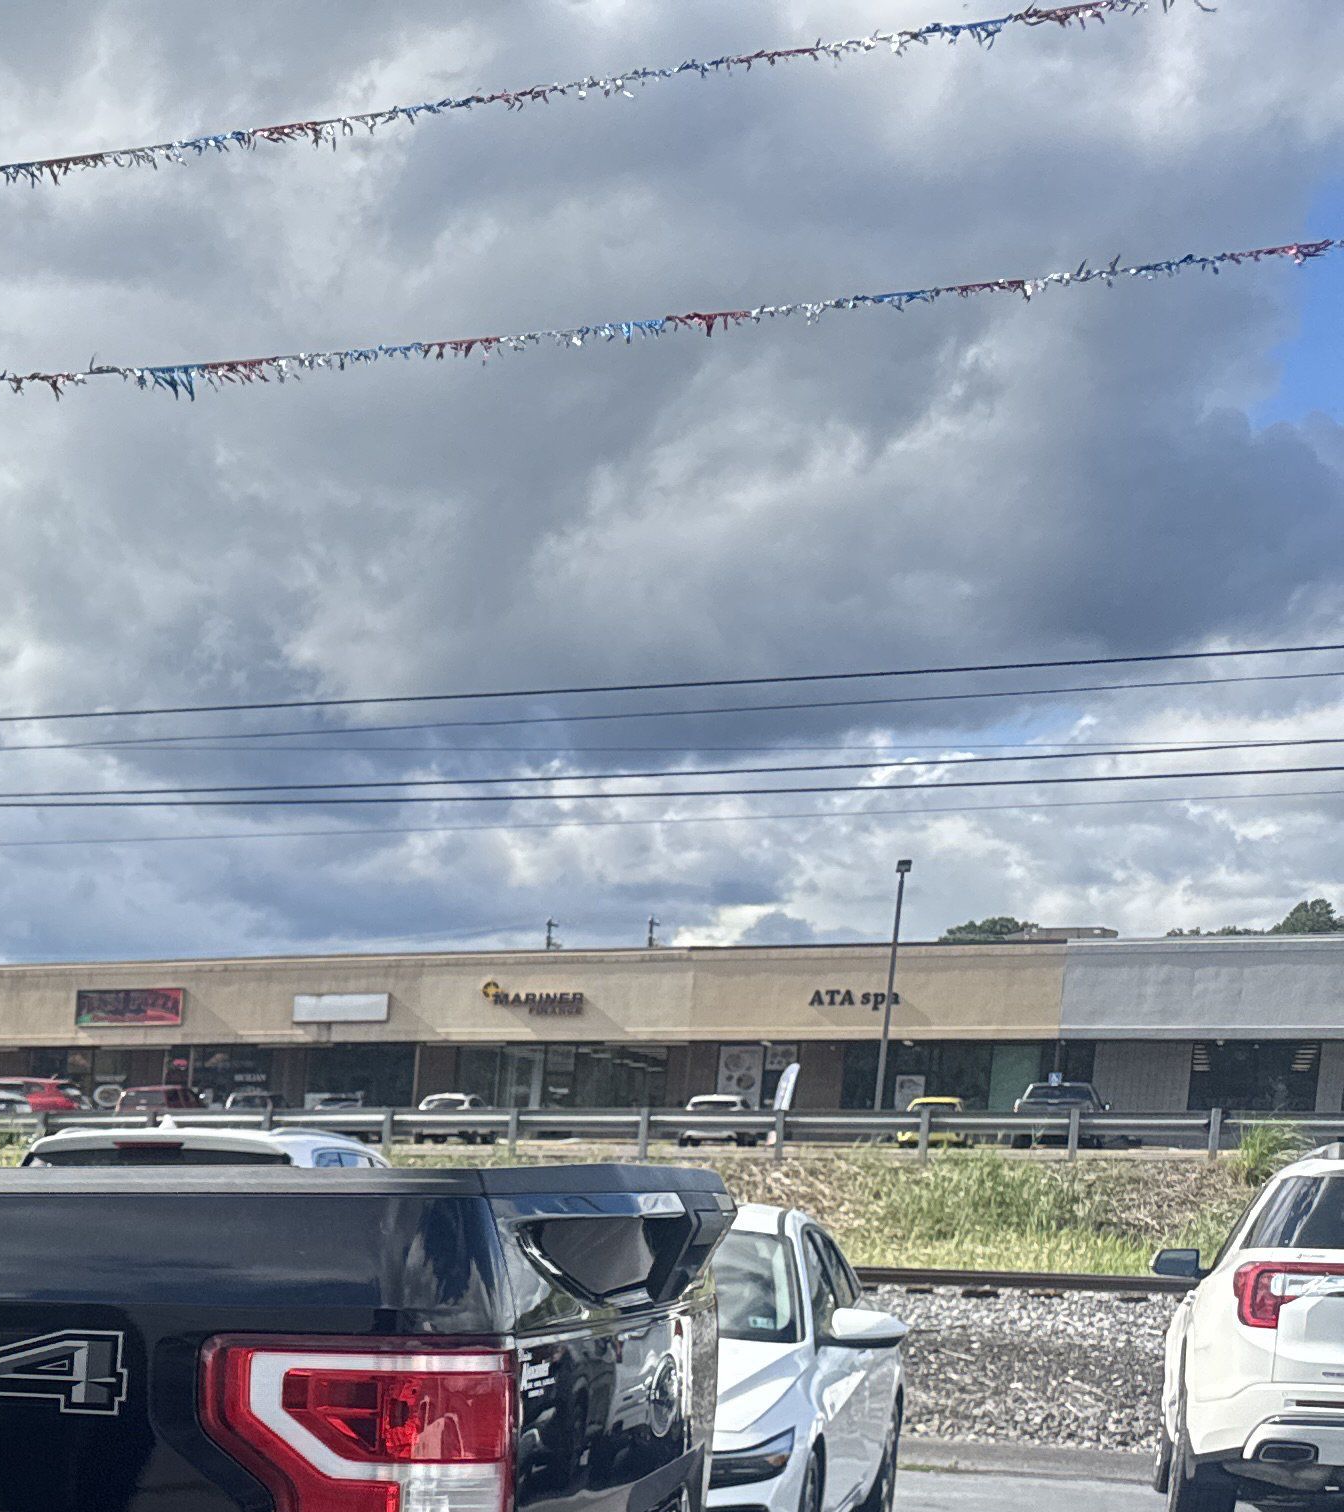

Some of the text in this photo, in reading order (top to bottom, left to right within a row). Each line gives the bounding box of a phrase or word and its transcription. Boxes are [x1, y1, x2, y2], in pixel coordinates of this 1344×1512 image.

[493, 992, 584, 1007] MARINER
[808, 989, 901, 1011] ATA spa
